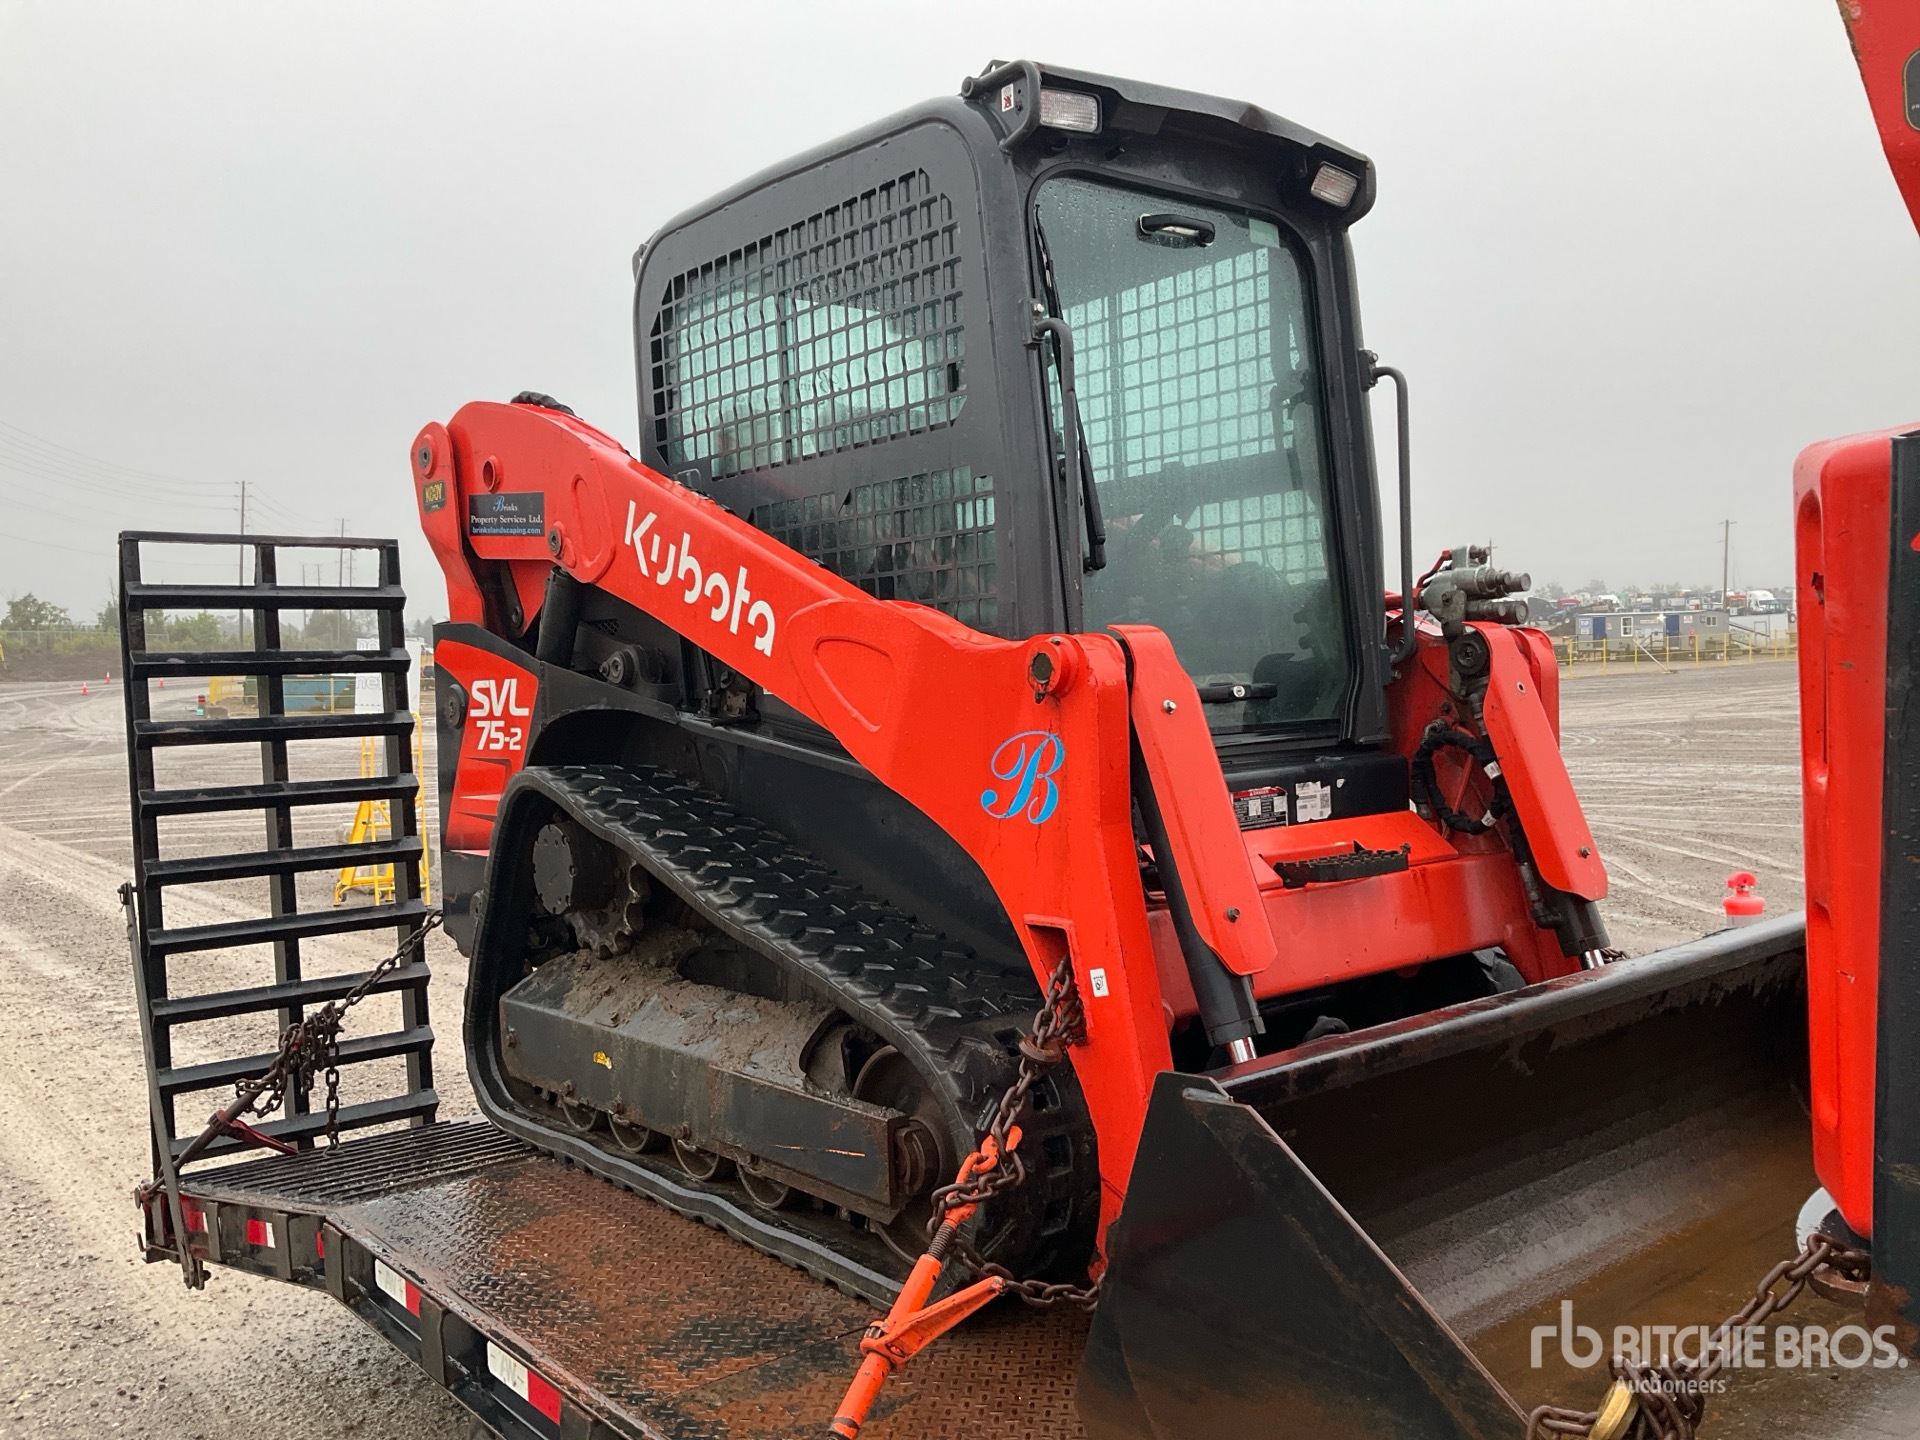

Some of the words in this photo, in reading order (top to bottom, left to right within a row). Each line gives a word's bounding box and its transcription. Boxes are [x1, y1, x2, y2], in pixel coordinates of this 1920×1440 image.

[492, 495, 518, 512] Brinks
[470, 515, 498, 525] Property
[499, 514, 527, 524] Services
[528, 514, 543, 524] Ltd.
[472, 526, 541, 535] brinkslandscaping.com
[624, 500, 776, 657] Kubota
[470, 678, 530, 717] SVL
[476, 720, 522, 750] 75-2
